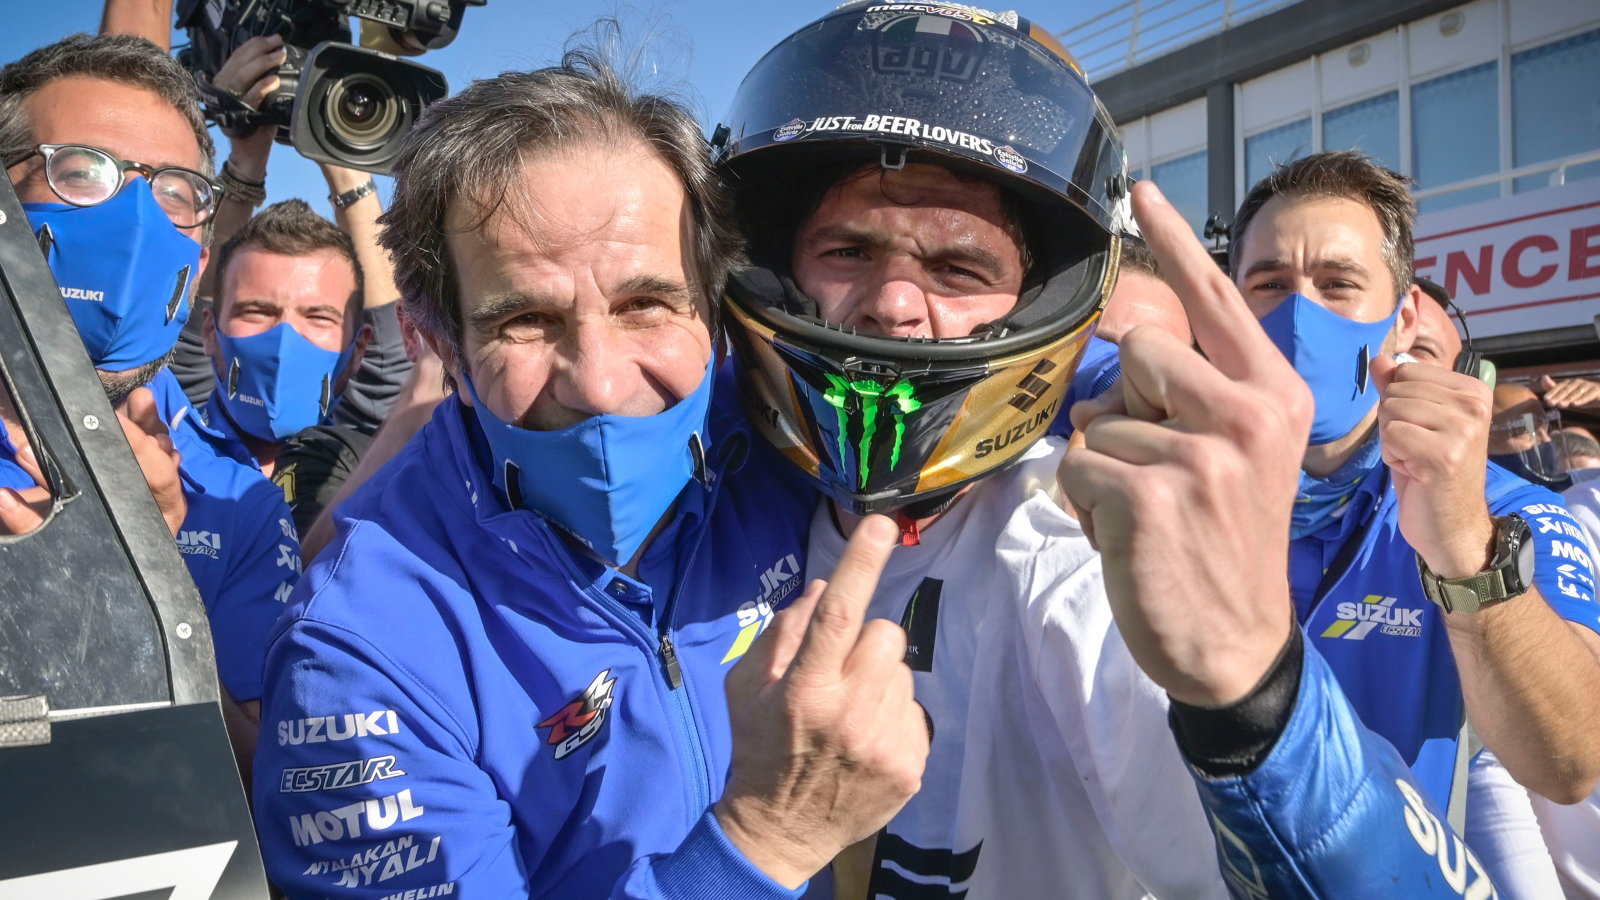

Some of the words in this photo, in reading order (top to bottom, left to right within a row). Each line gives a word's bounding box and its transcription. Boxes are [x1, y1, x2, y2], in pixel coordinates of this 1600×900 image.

[806, 116, 856, 132] JUST
[862, 114, 920, 137] BEER
[922, 124, 993, 156] LOVERS
[58, 287, 104, 302] UZUKI
[239, 394, 264, 407] SUZUKI
[975, 398, 1058, 459] SUZUKI
[1335, 602, 1424, 628] SUZUK
[1379, 624, 1422, 637] ECSTA
[277, 709, 400, 747] SUZUKI
[279, 755, 408, 793] ECSTAR
[289, 788, 424, 847] MOTUL
[302, 834, 413, 876] NYALAKAN
[331, 836, 441, 889] NYALI
